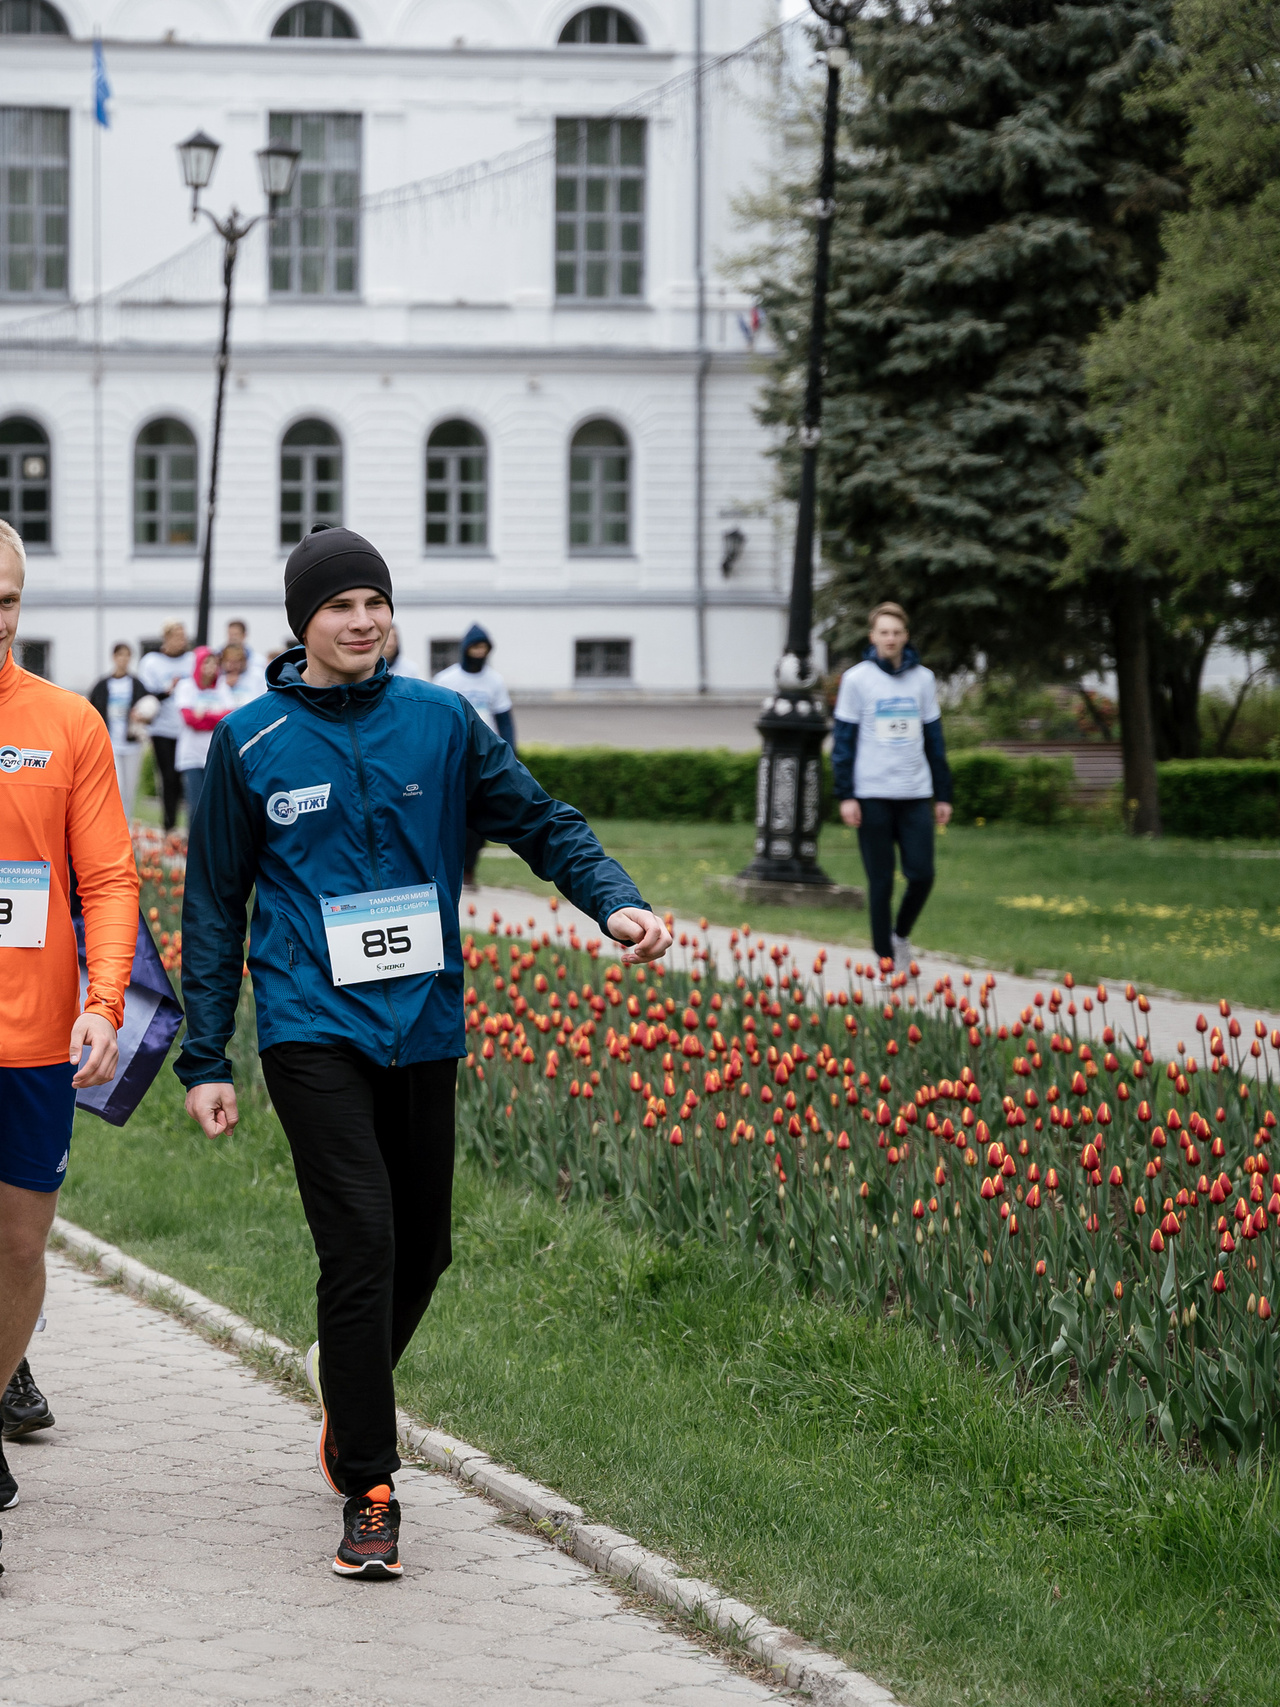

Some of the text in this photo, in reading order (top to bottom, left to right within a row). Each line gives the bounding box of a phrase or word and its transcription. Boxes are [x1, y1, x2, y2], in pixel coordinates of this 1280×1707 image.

[297, 797, 326, 811] ТТЖТ
[368, 891, 430, 905] ТАМАНСКАЯ МИЛЯ
[376, 905, 403, 914] СЕРДЦЕ
[403, 901, 429, 910] СИБИРИ
[361, 925, 412, 958] 85
